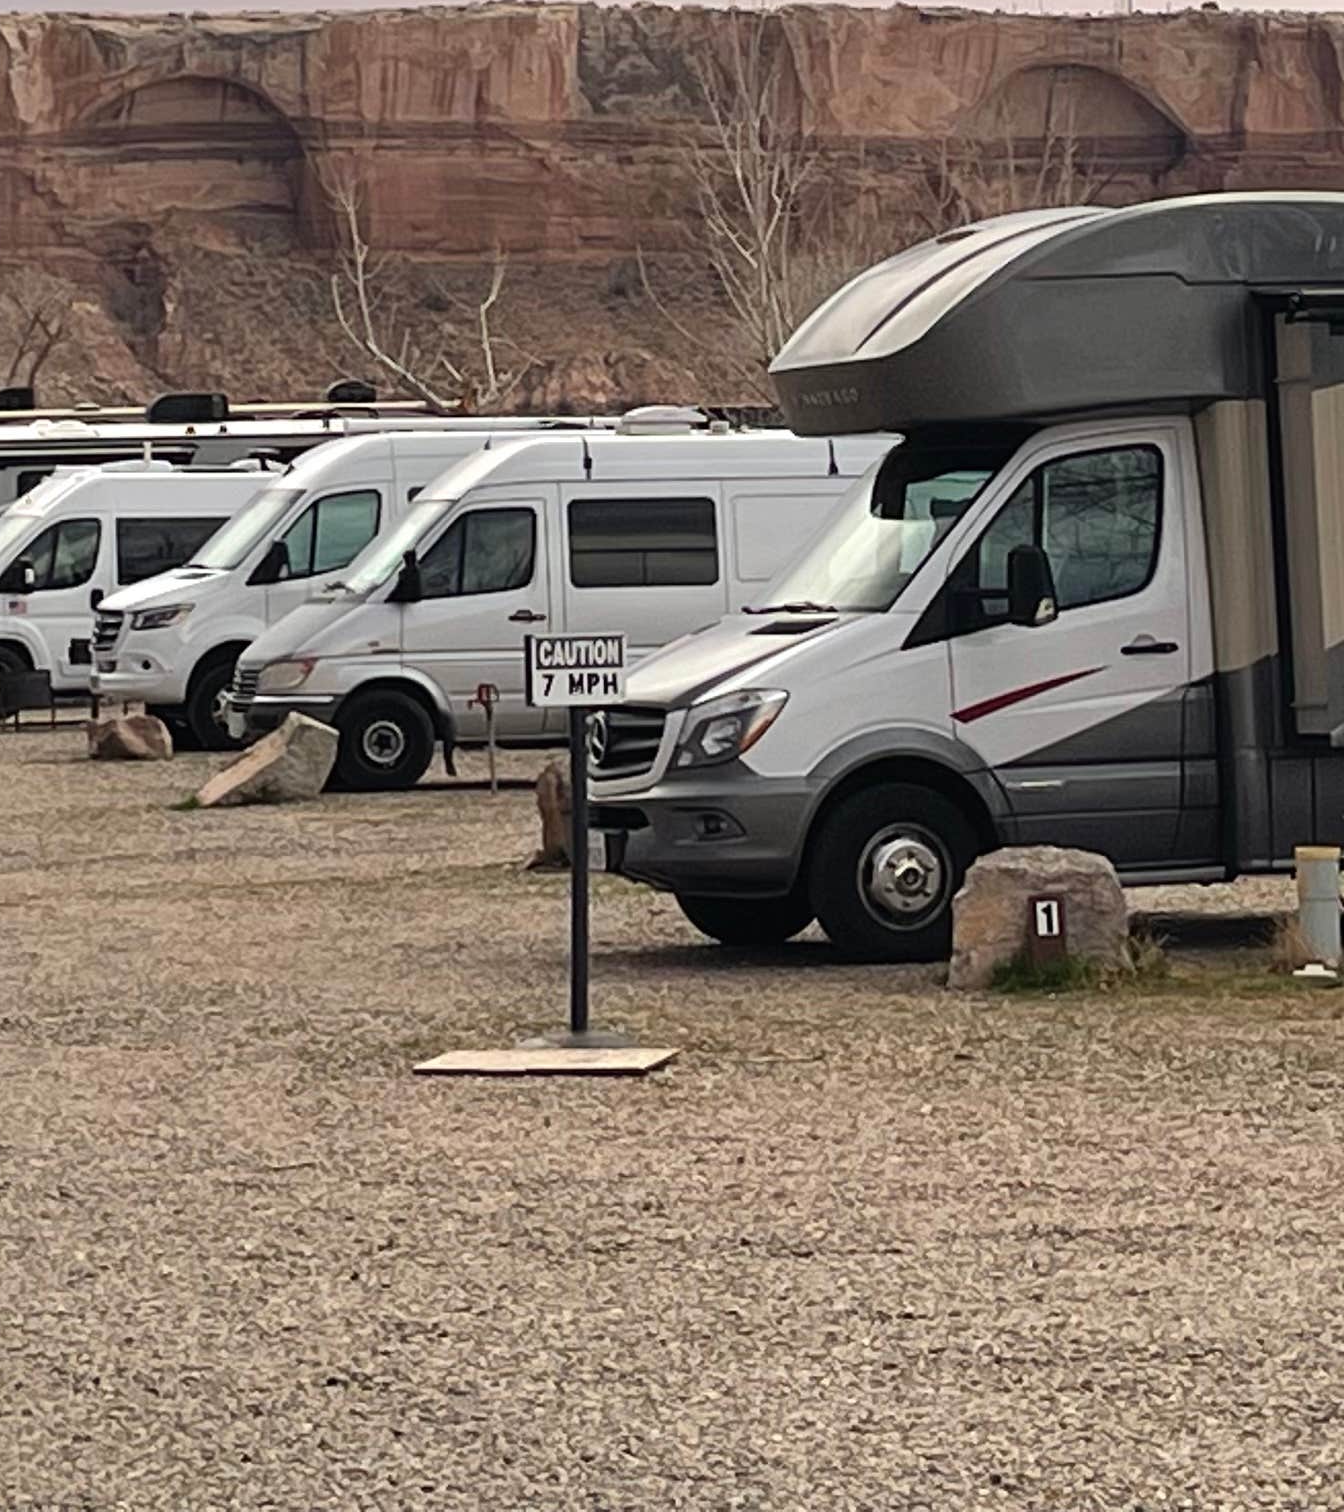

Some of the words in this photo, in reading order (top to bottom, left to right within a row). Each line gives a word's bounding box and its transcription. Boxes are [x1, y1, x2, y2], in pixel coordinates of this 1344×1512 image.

[539, 638, 620, 666] CAUTION
[542, 673, 555, 697] 7
[568, 672, 619, 696] MPH
[1040, 902, 1054, 934] 1
